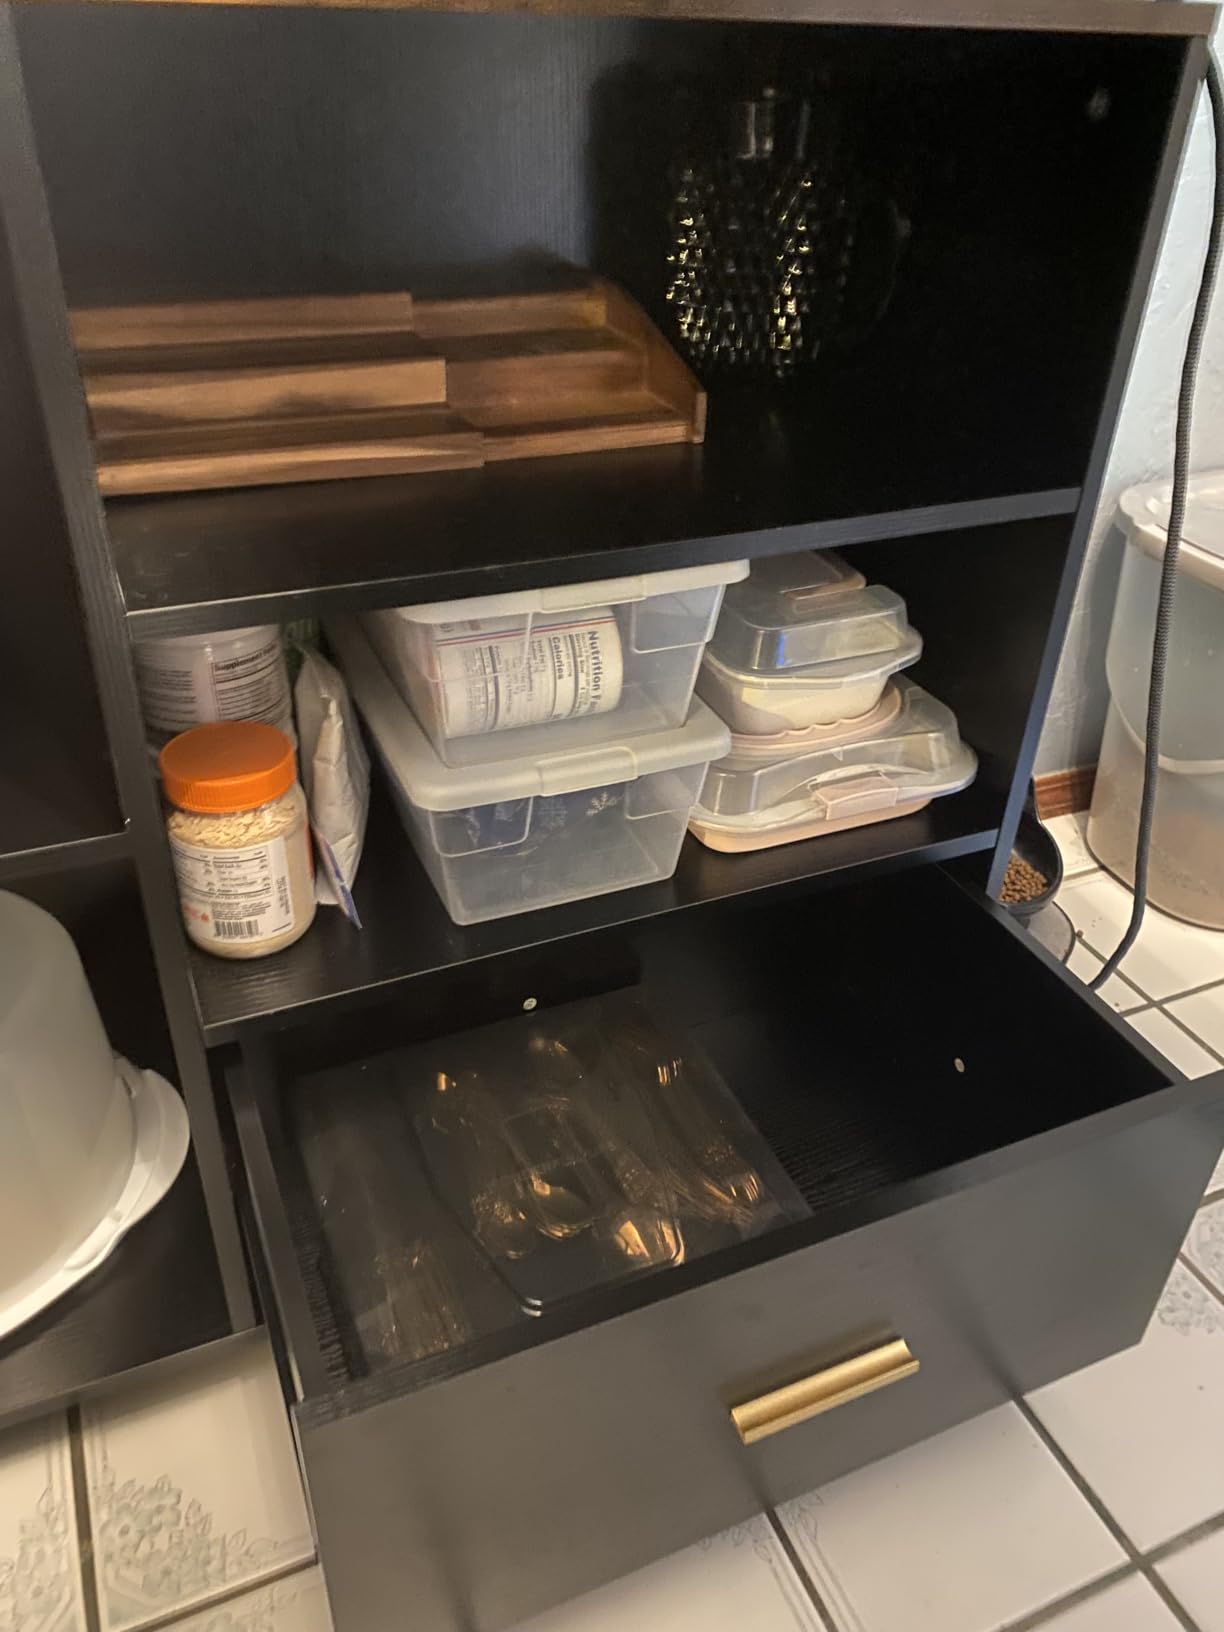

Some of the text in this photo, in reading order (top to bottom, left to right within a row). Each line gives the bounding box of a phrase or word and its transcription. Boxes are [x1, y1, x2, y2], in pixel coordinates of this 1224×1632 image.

[215, 651, 262, 672] Supplement
[552, 637, 565, 680] Calories
[588, 631, 604, 691] Nutrition
